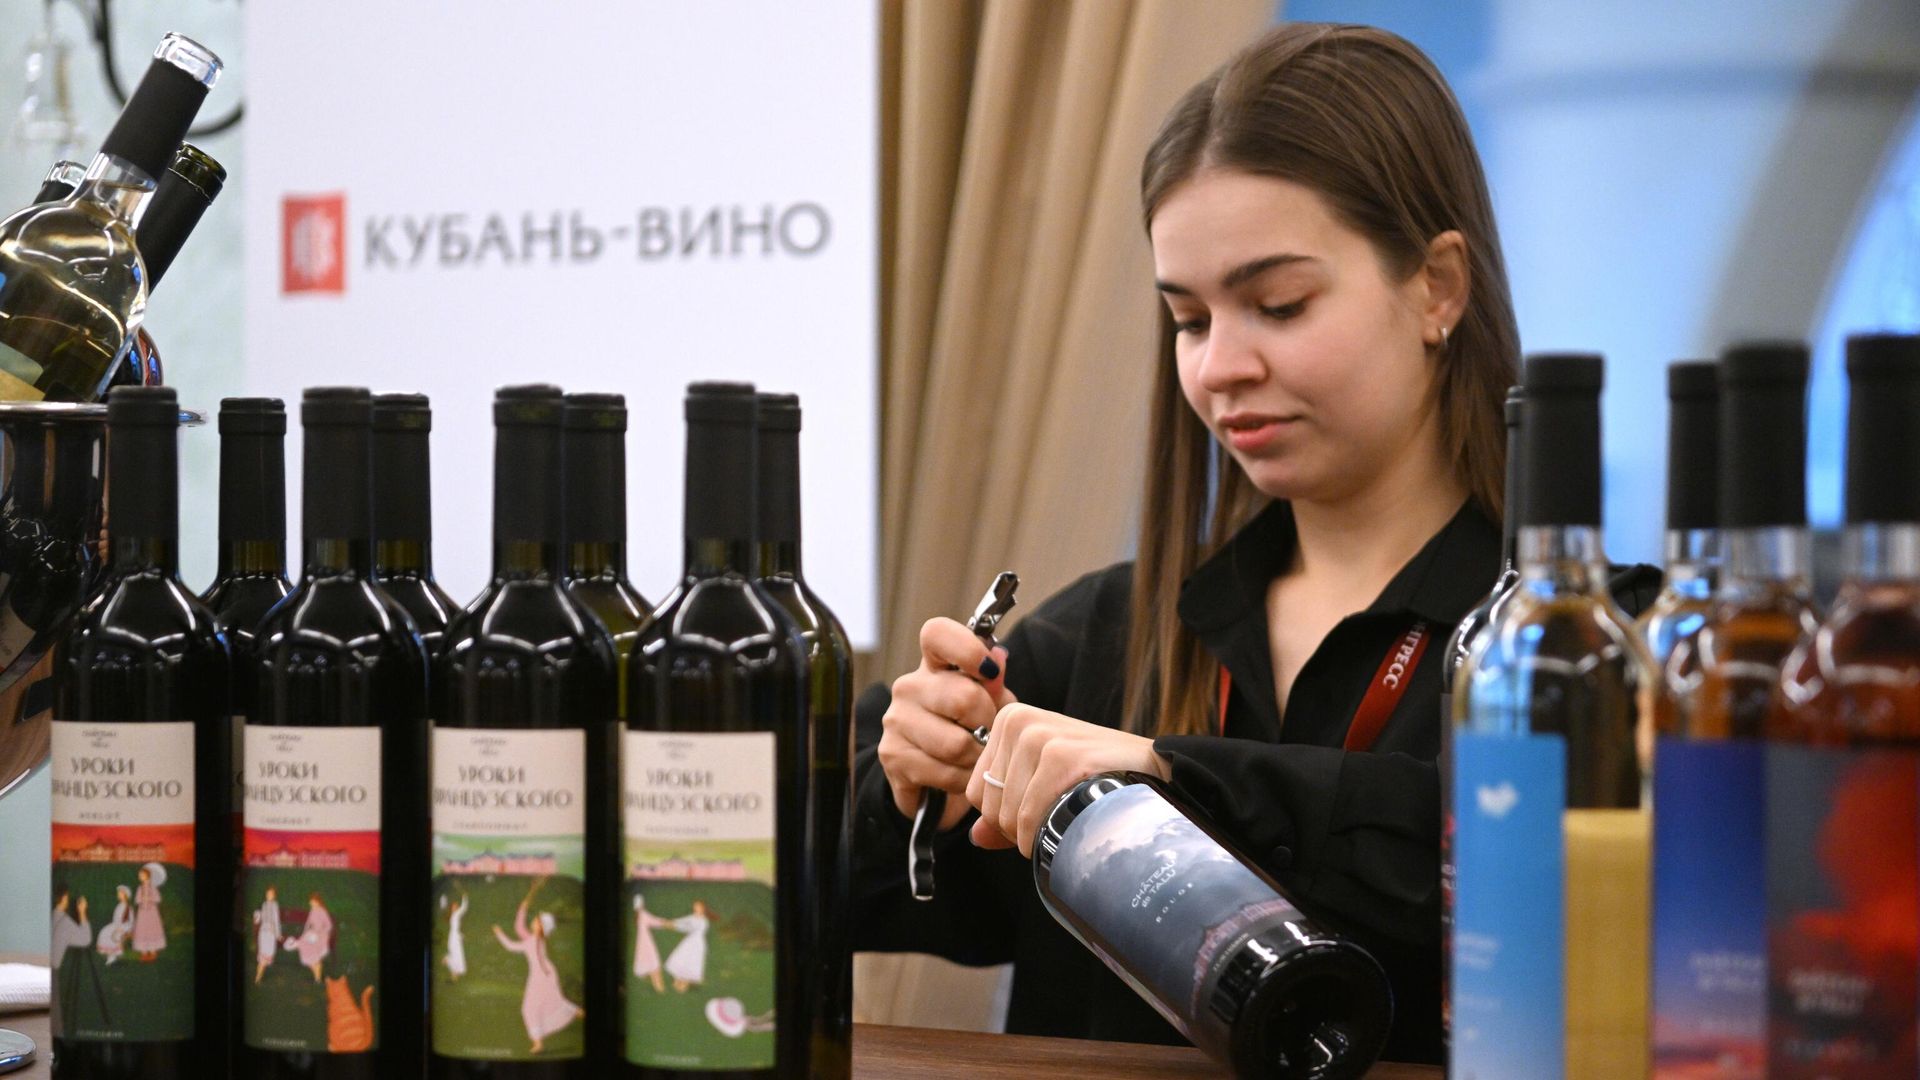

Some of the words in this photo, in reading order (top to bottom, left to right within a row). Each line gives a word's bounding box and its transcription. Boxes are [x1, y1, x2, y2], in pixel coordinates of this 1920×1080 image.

[362, 201, 833, 267] КУБАНЬ-ВИНО
[71, 756, 135, 777] УРОКИ
[258, 761, 319, 781] УРОКИ
[458, 764, 526, 784] УРОКИ
[646, 767, 714, 788] УРОКИ
[244, 783, 367, 805] РАНЦУЗСКОГО
